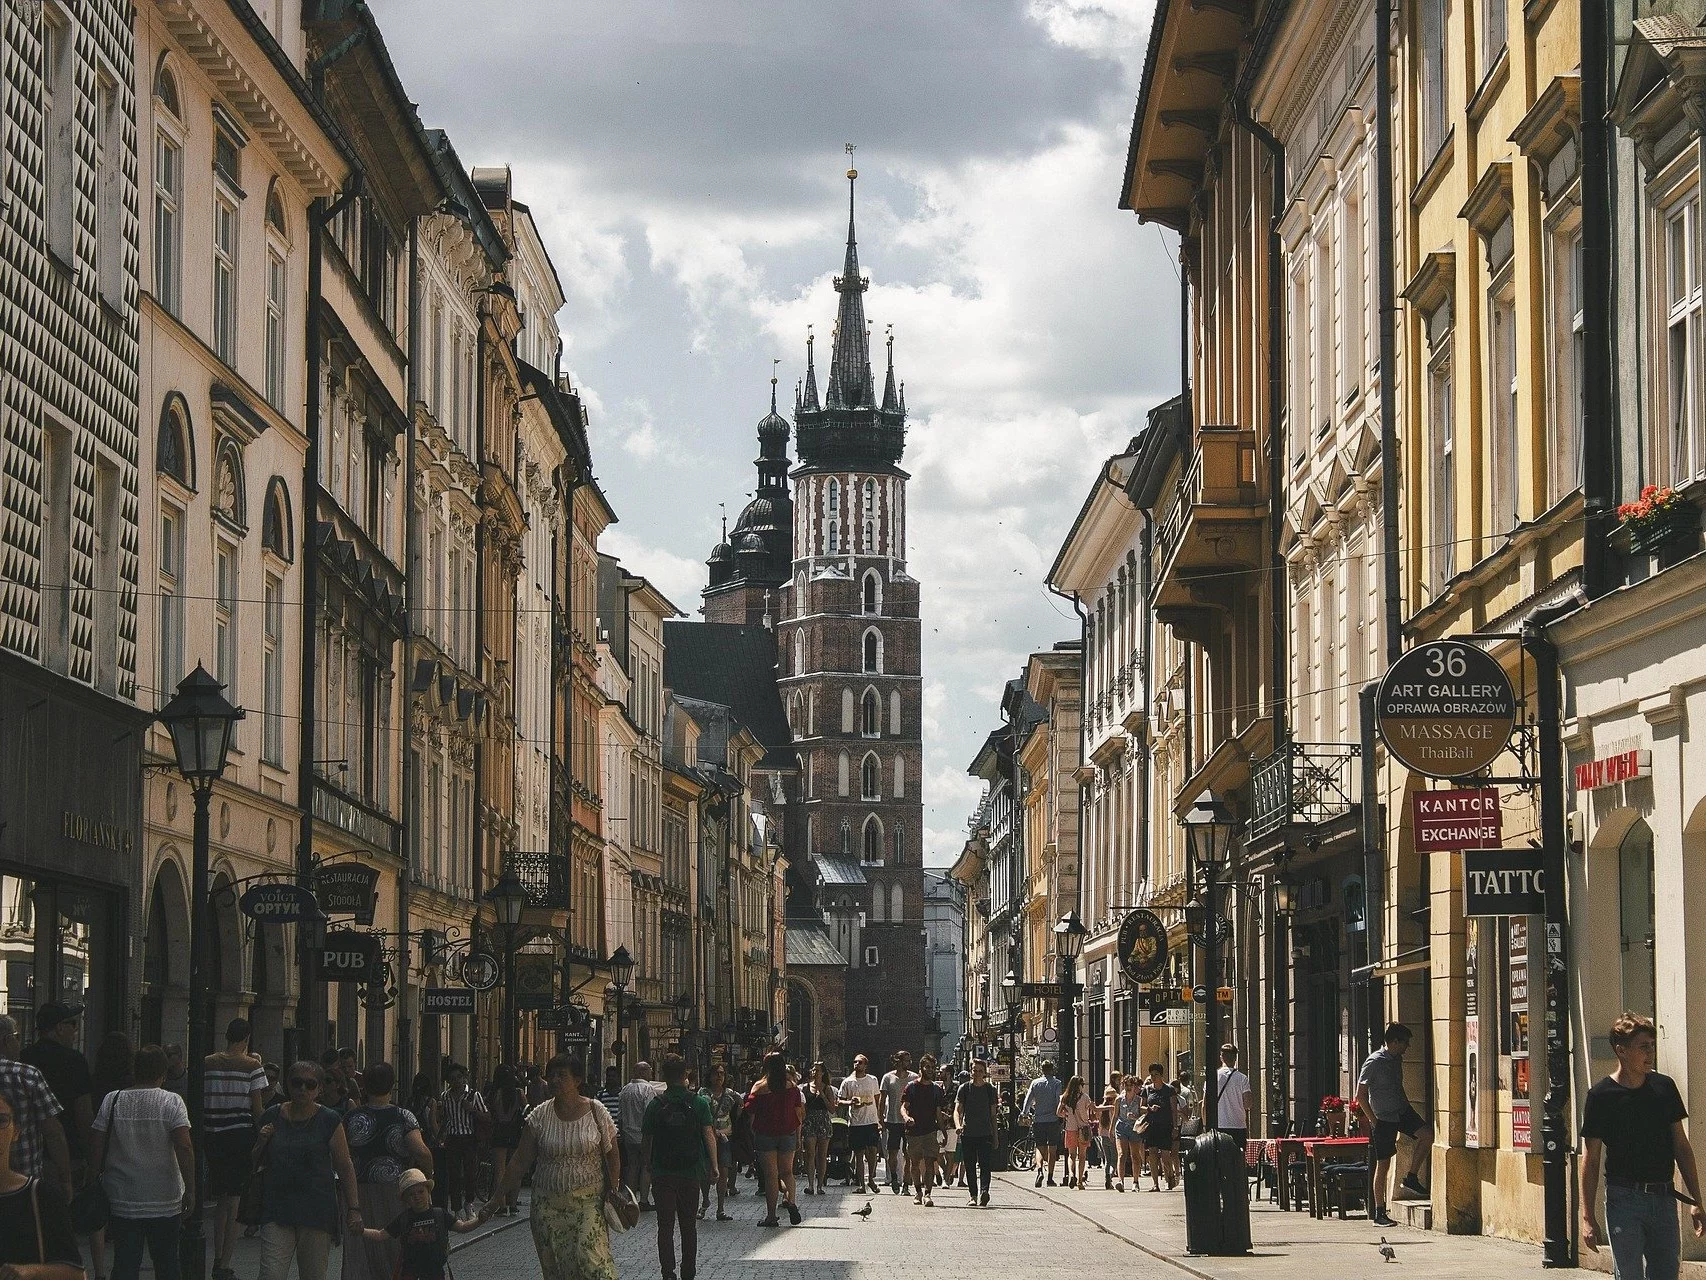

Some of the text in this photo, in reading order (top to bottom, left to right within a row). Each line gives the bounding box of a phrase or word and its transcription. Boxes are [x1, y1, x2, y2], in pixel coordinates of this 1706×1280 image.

[1424, 647, 1467, 677] 36
[1391, 684, 1502, 698] ART GALLERY
[1387, 701, 1507, 714] OPRAWA OBRAZÓW
[1400, 724, 1494, 740] MASSAGE
[1418, 745, 1474, 760] ThaiBali
[1419, 797, 1495, 813] KANTOR
[1421, 825, 1497, 842] EXCHANGE
[1469, 869, 1545, 895] TATTO
[253, 902, 300, 914] OPTYK
[322, 951, 365, 968] PUB
[1034, 985, 1064, 995] HOTEL
[427, 996, 473, 1008] HOSTEL
